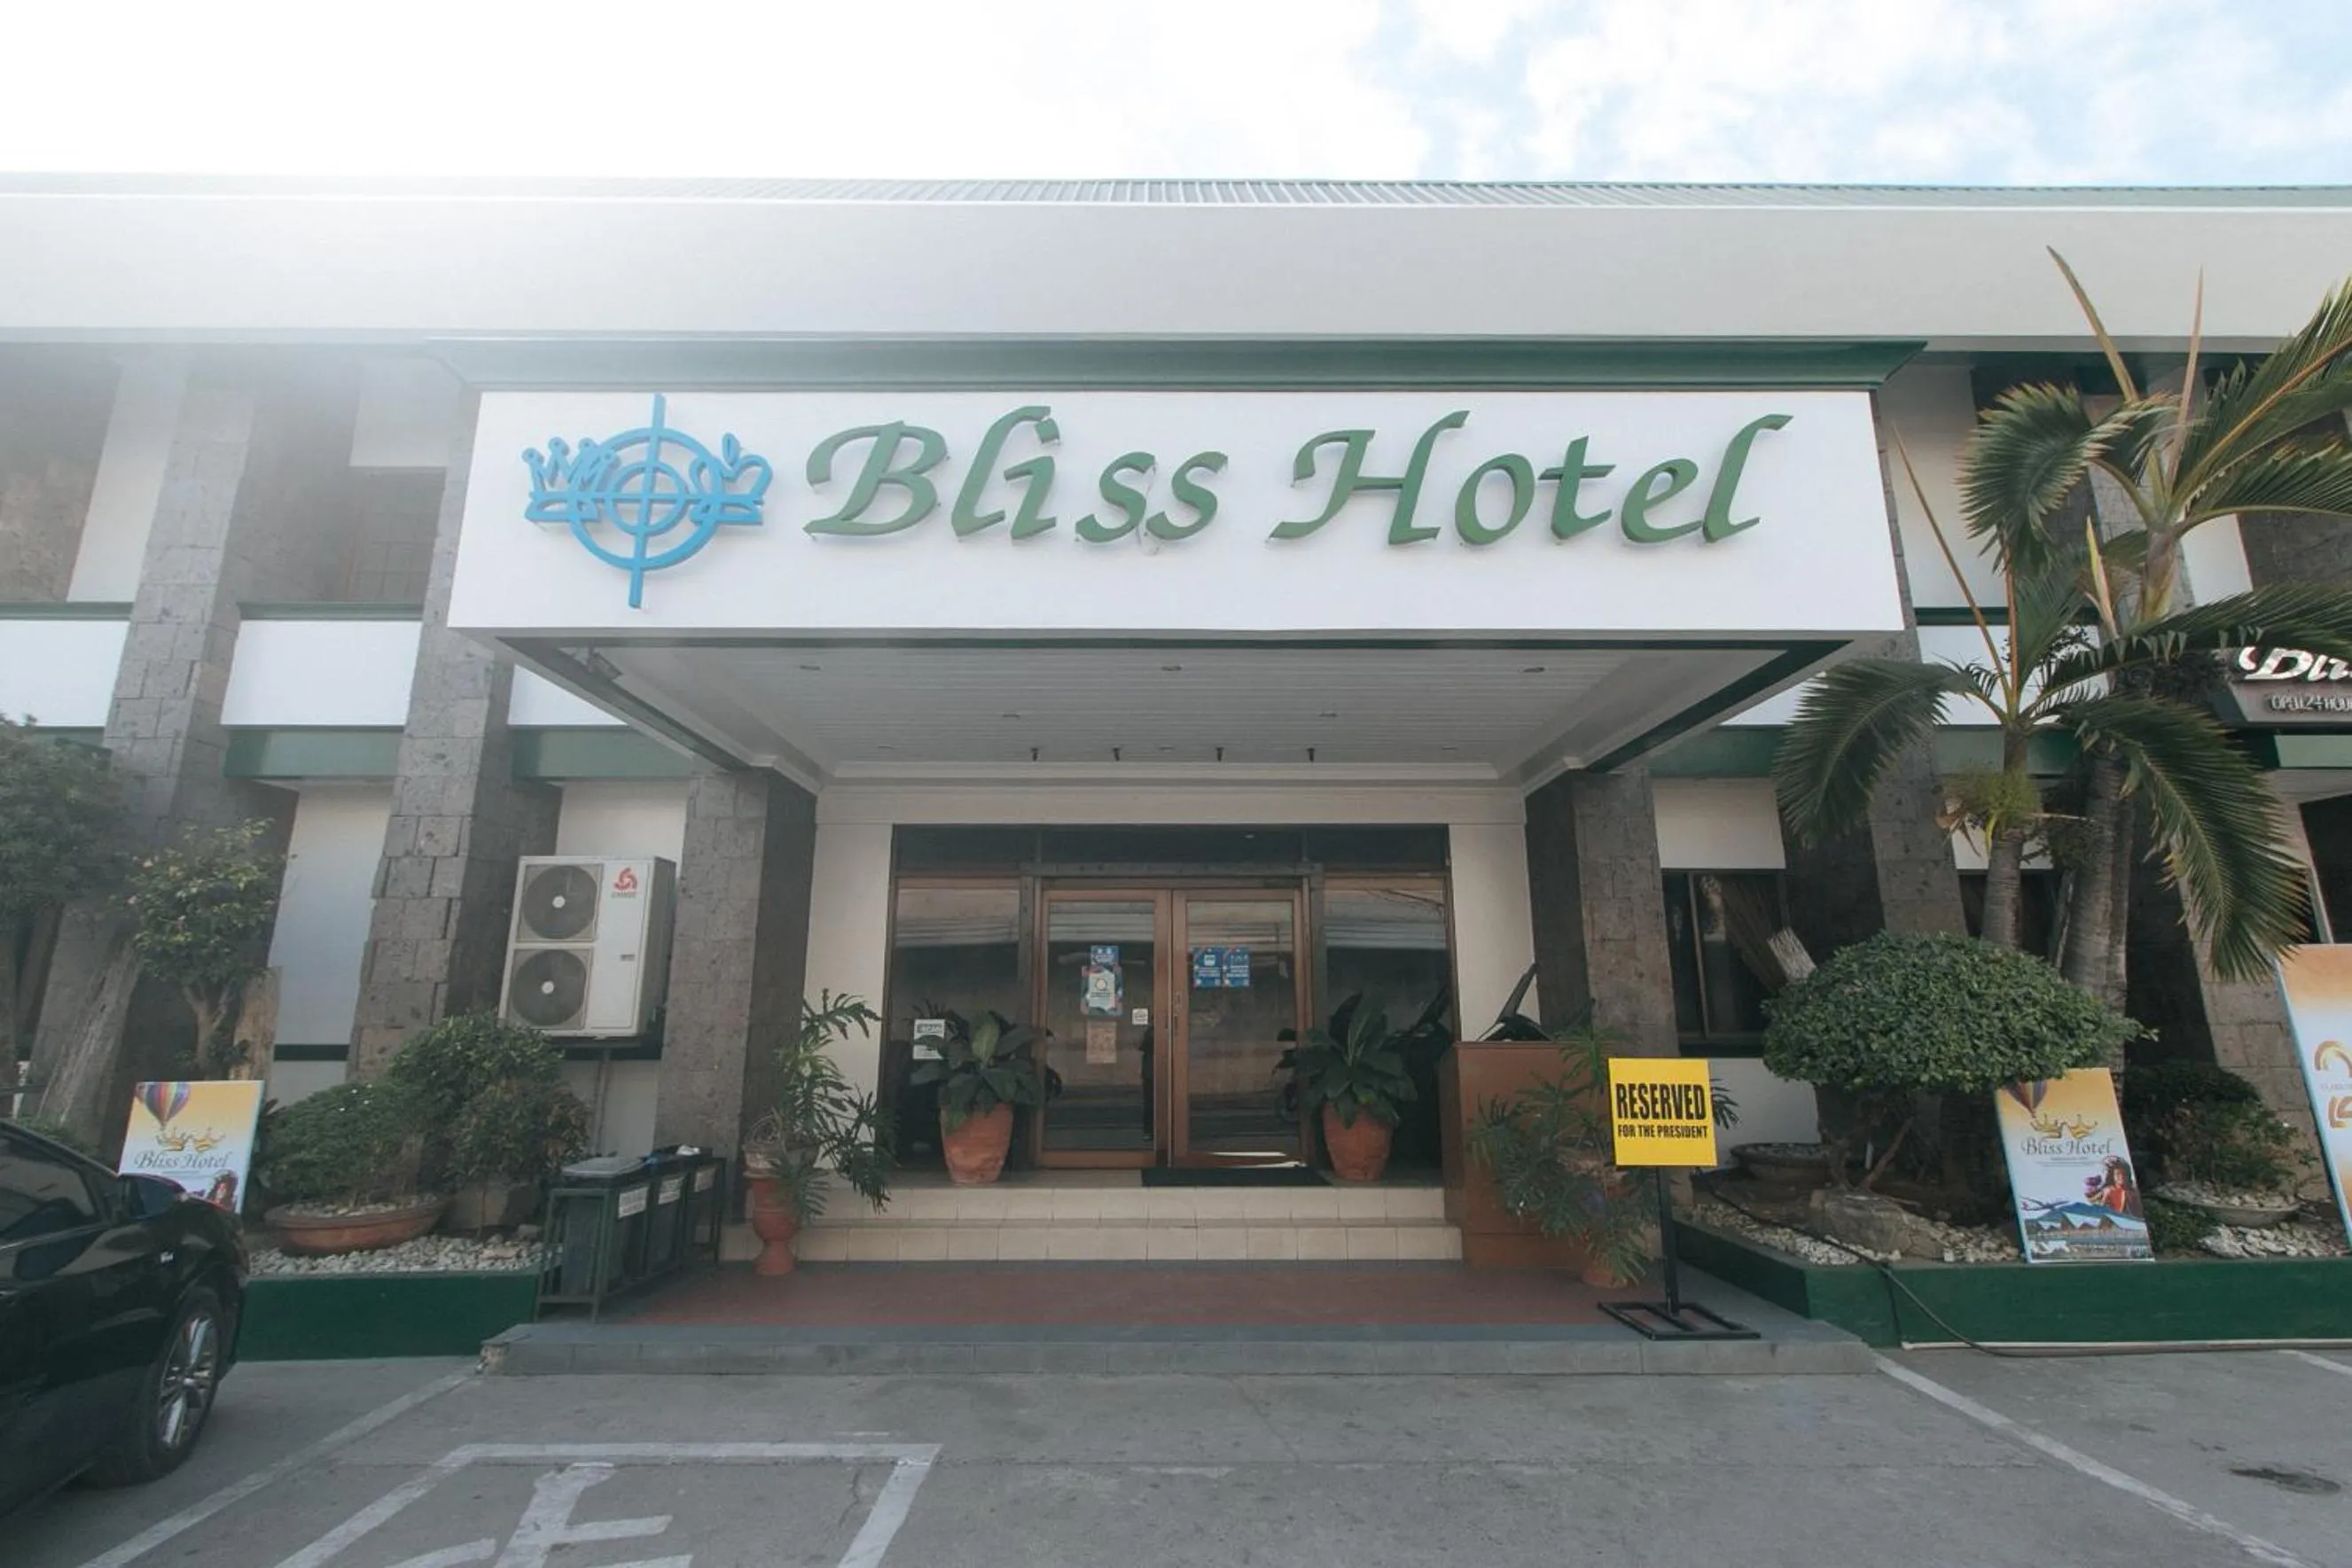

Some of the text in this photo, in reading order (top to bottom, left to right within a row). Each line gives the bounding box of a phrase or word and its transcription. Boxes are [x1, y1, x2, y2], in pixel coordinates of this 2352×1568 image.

[802, 406, 1793, 545] Bliss Hotel
[1615, 1083, 1707, 1120] RESERVED
[1618, 1125, 1708, 1139] FOR THE PRESIDENT
[2020, 1136, 2114, 1156] Bliss Hotel
[134, 1150, 233, 1170] Bliss Hotel
